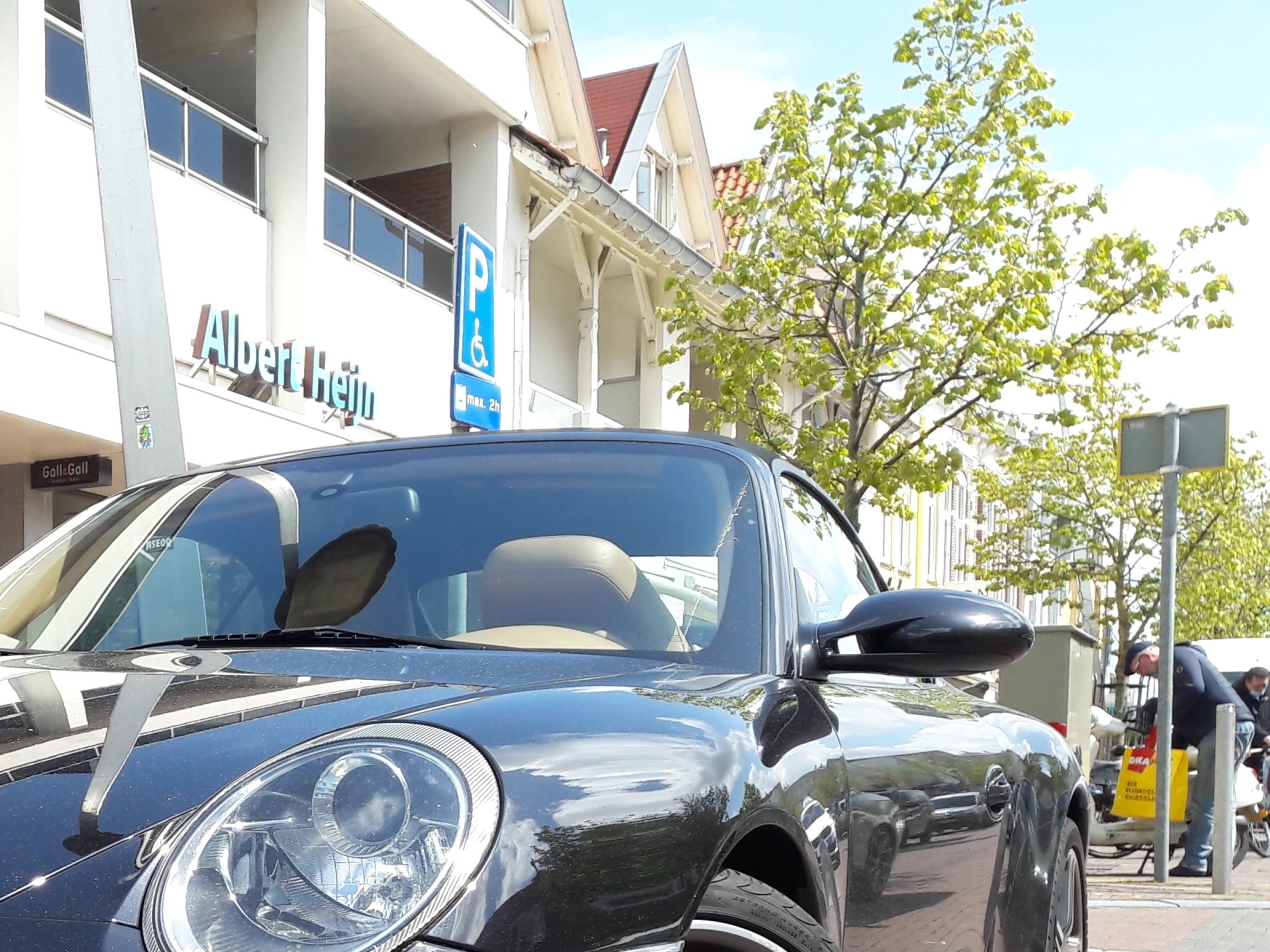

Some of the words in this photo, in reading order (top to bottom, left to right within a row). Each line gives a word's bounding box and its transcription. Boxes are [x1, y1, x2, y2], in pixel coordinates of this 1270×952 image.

[469, 241, 489, 313] P
[195, 304, 302, 392] Albert
[306, 346, 378, 427] Heijn
[467, 393, 487, 409] max.
[489, 398, 501, 413] 2h
